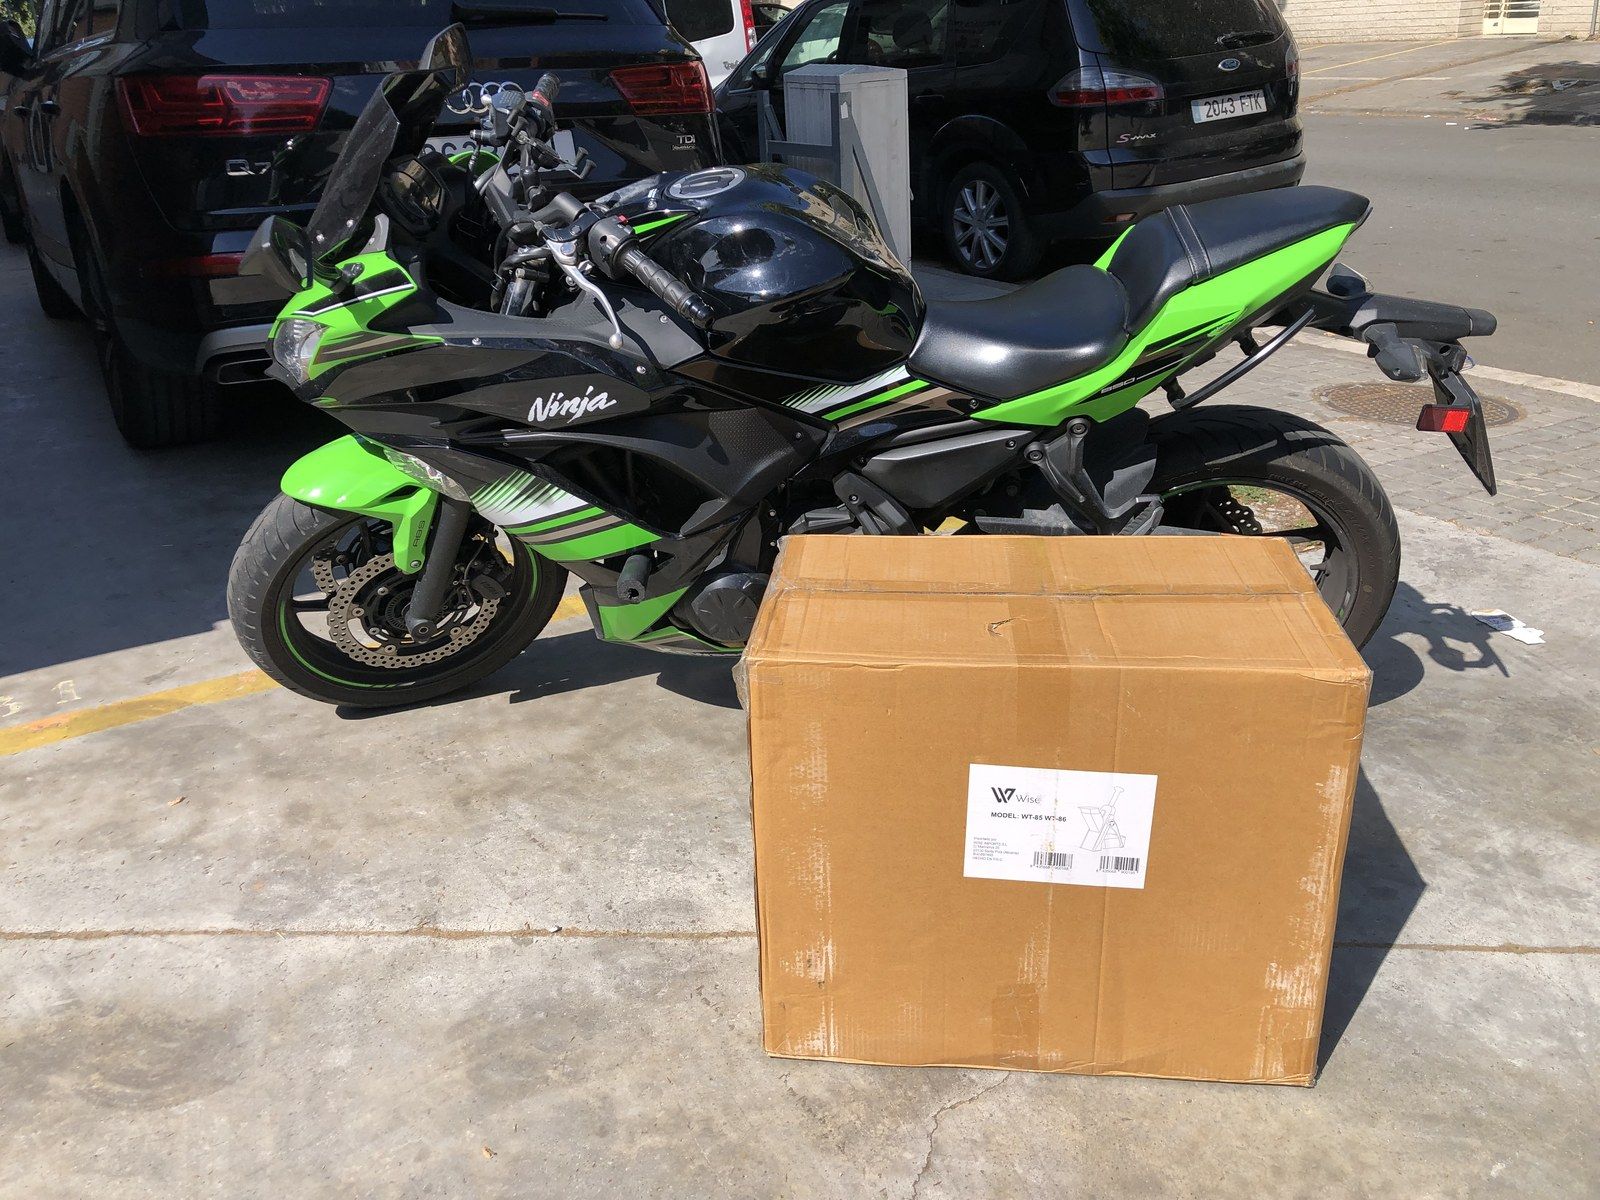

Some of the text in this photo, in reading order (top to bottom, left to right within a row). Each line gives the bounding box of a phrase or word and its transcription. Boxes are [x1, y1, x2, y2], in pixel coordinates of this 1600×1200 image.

[1204, 93, 1262, 118] 2043 FTK
[676, 134, 696, 144] TDI
[225, 159, 272, 176] Q7
[527, 385, 617, 424] Ninja
[412, 520, 426, 548] ABS
[991, 811, 1020, 819] MODEL:
[1021, 813, 1043, 821] WT-85
